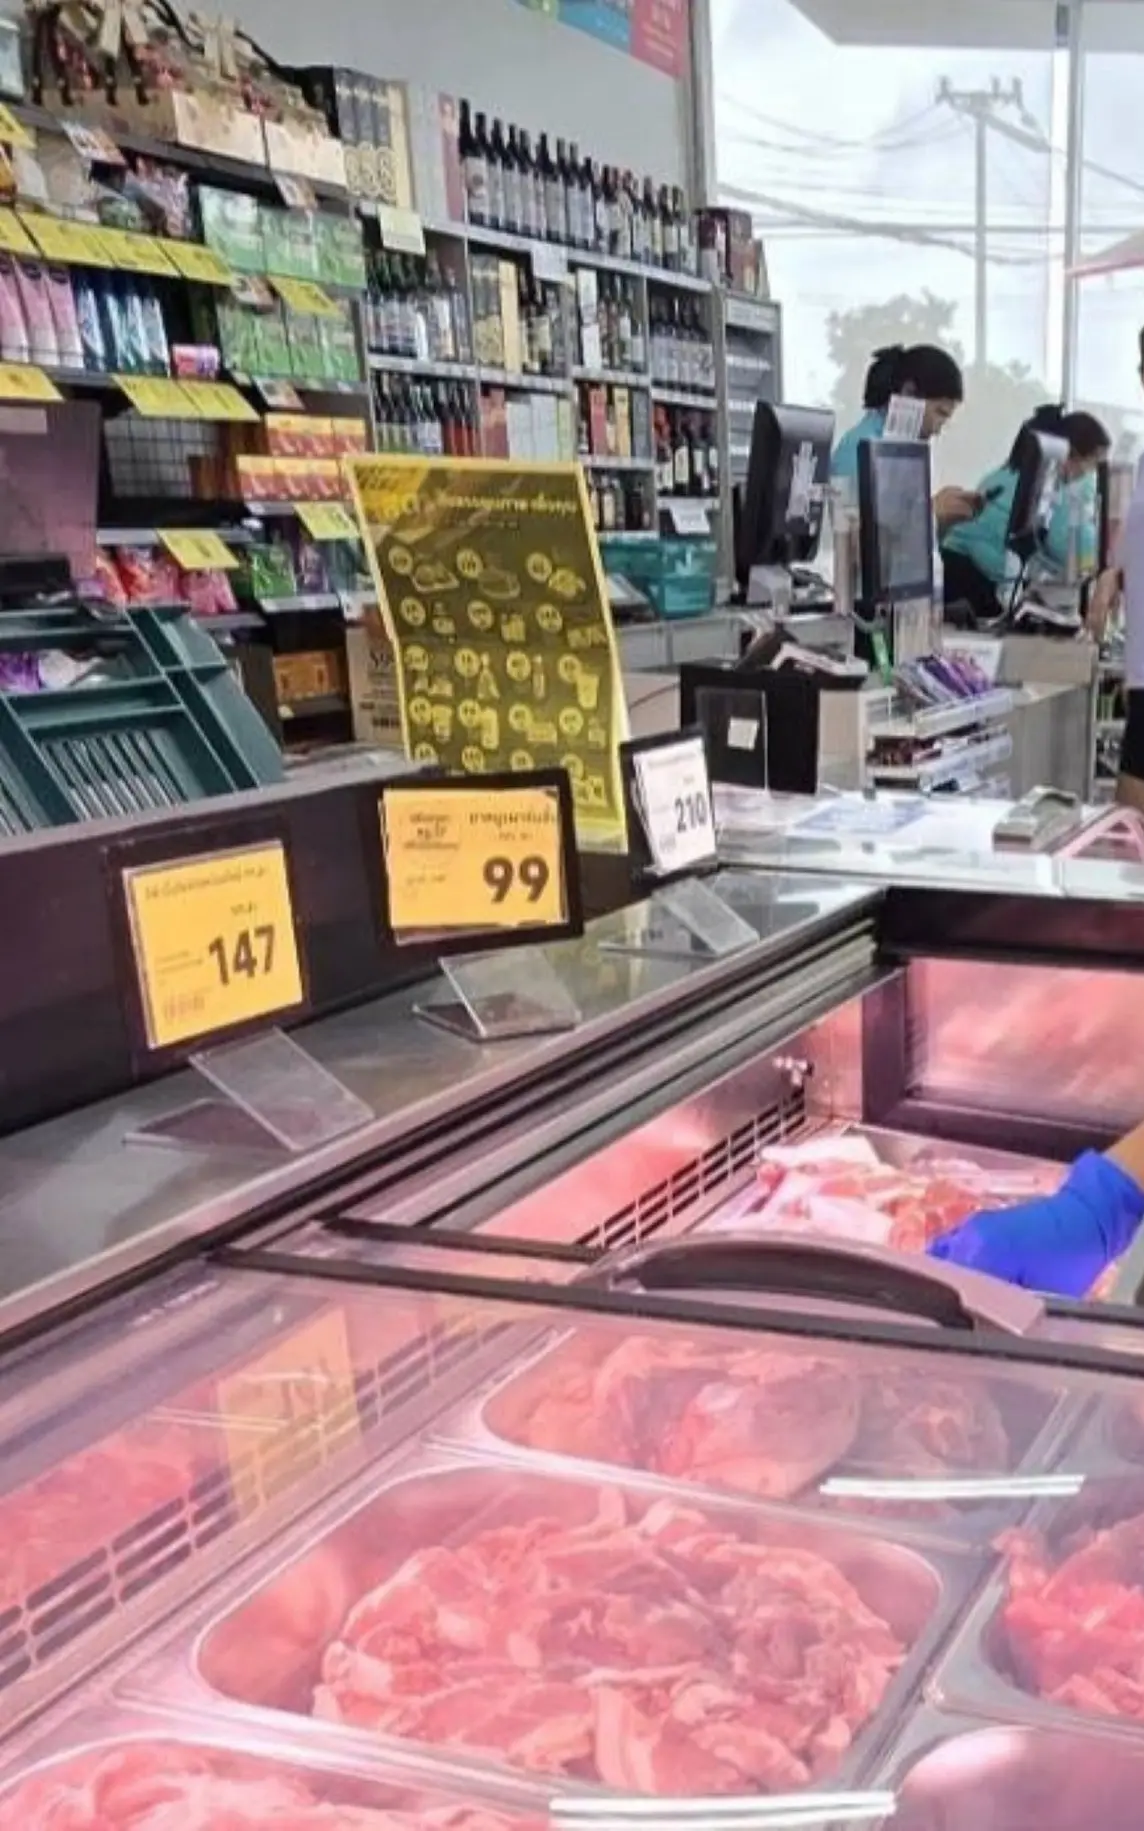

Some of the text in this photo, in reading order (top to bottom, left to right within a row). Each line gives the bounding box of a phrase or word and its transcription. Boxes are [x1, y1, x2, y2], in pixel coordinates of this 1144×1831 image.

[674, 791, 708, 833] 210
[483, 855, 550, 904] 99
[208, 924, 275, 987] 147
